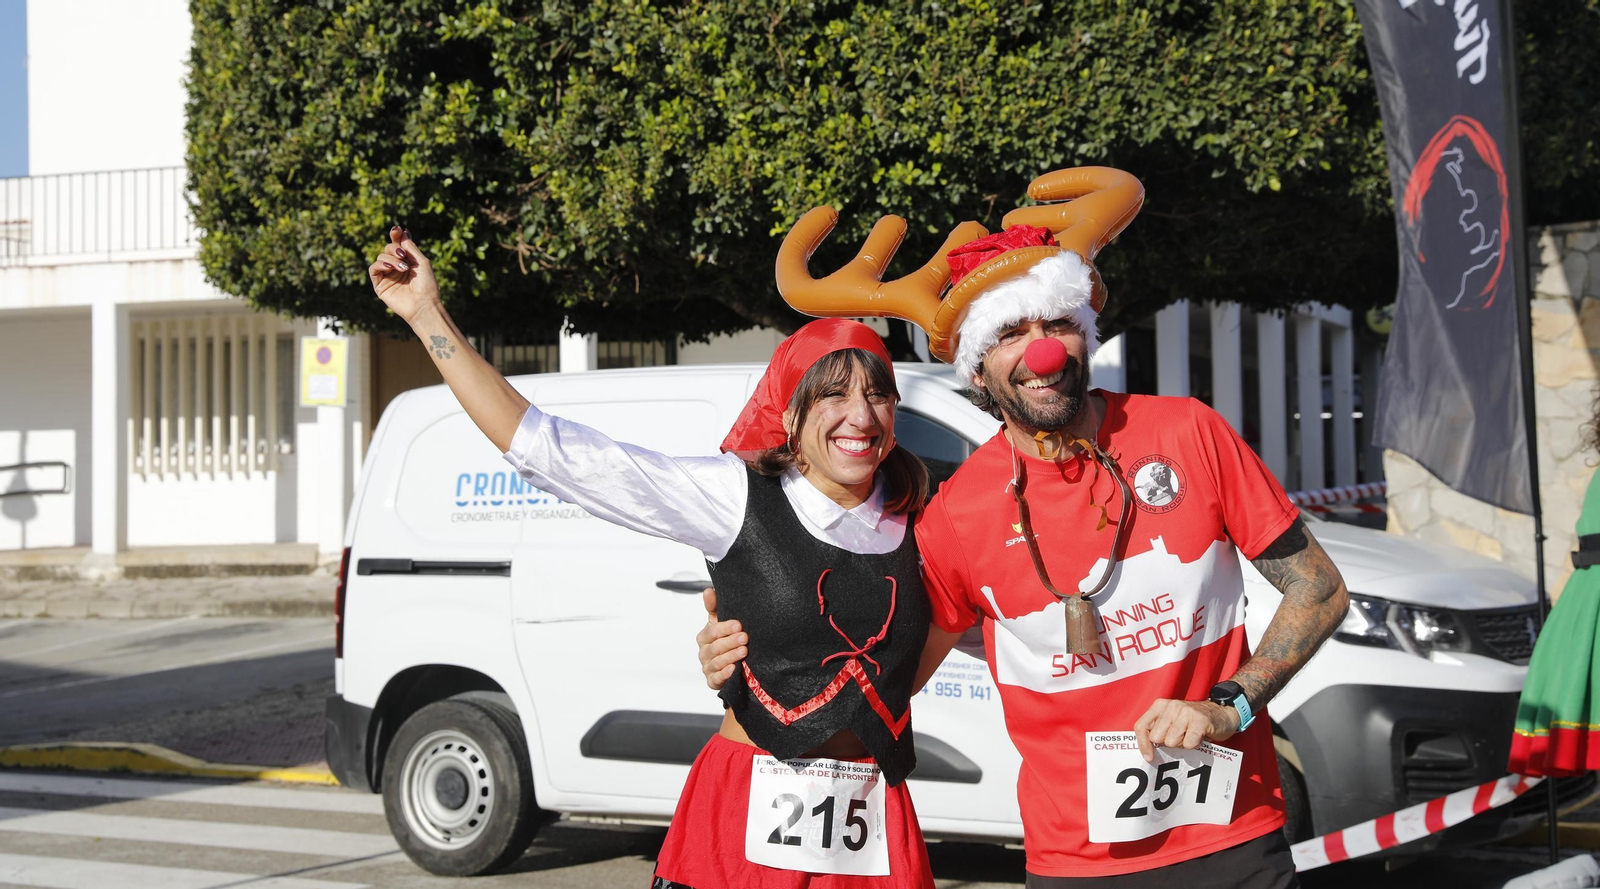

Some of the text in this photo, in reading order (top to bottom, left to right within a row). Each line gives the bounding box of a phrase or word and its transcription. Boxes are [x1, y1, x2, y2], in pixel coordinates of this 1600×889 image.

[1128, 456, 1173, 478] RUNNING
[1135, 481, 1185, 512] SAN ROQUE
[451, 510, 520, 523] CRONOMETRAJE
[521, 510, 528, 519] Y
[1098, 593, 1175, 635] UNNING
[1051, 605, 1205, 677] SAN ROQUE
[935, 682, 962, 698] 955
[969, 684, 991, 701] 141
[832, 771, 841, 779] LA
[1115, 761, 1212, 819] 251
[767, 792, 868, 852] 215
